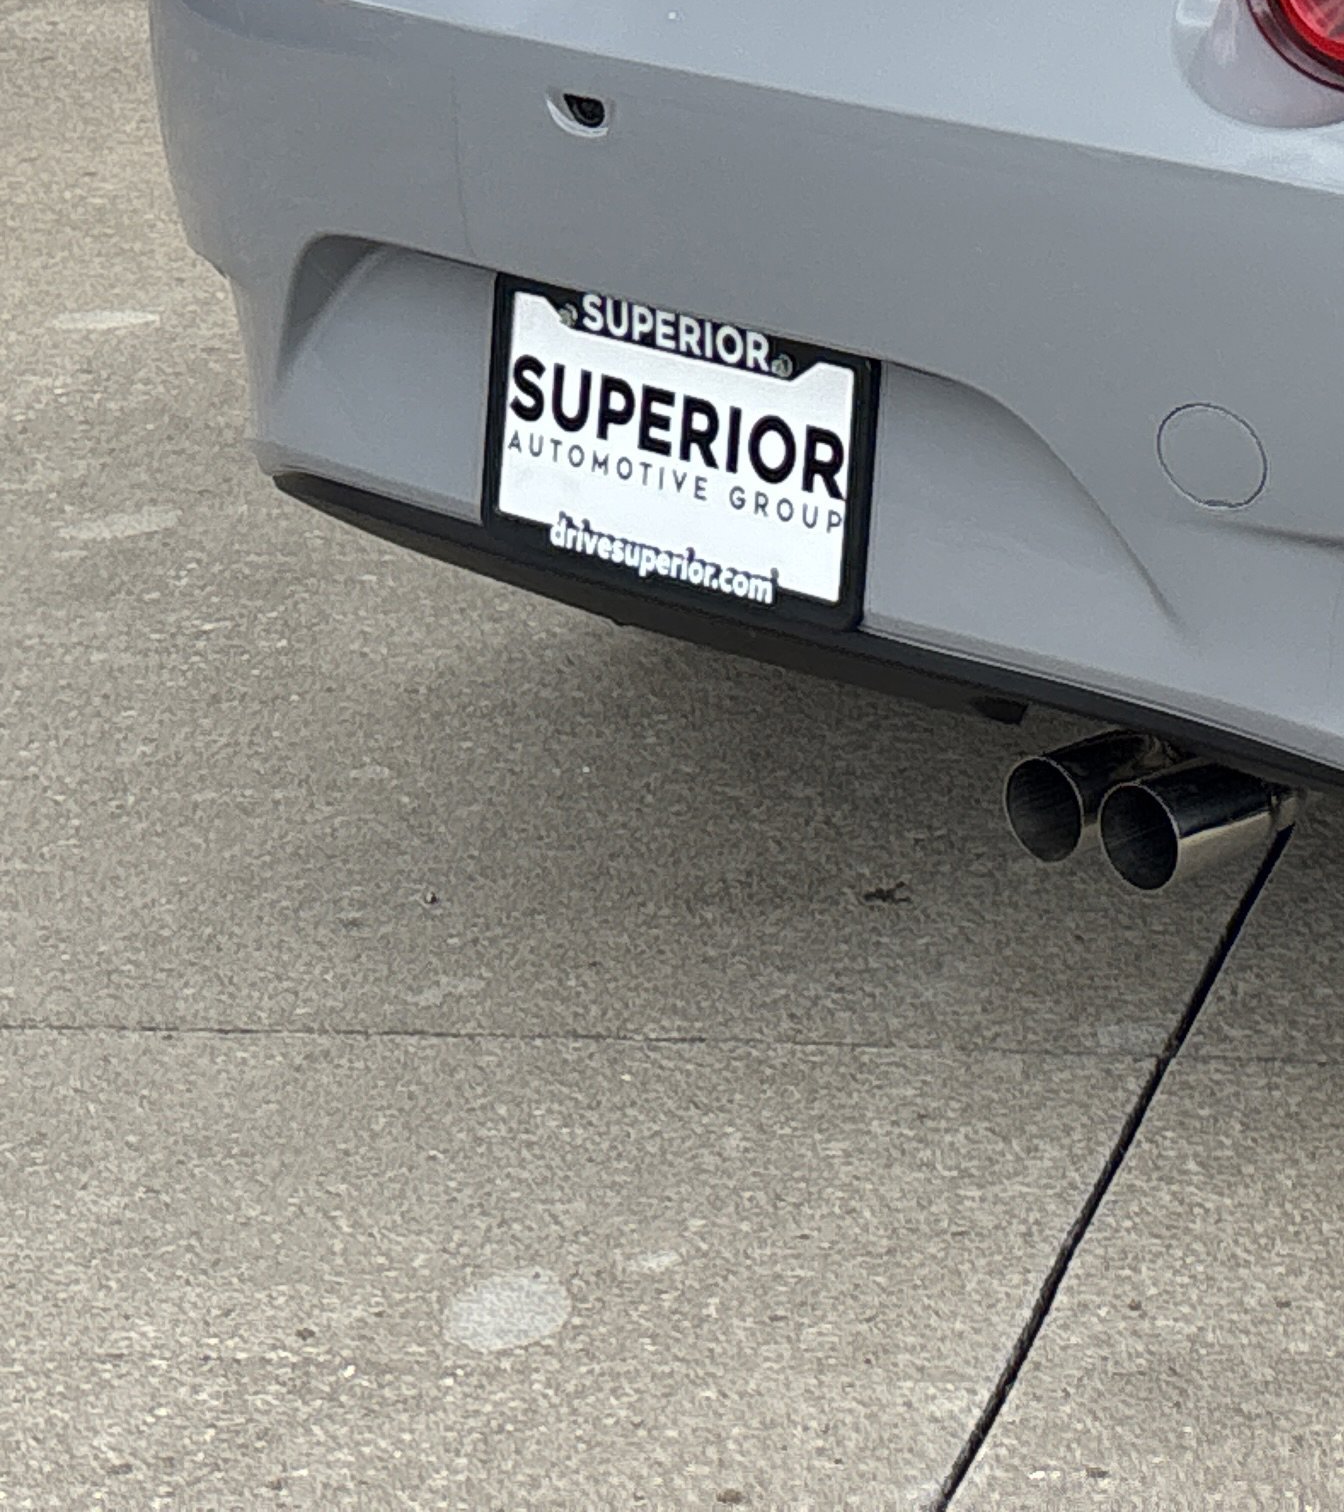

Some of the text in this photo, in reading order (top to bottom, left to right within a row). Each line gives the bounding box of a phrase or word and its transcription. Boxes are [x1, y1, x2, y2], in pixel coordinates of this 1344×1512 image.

[582, 293, 771, 372] SUPERIOR
[509, 354, 846, 500] SUPERIOR
[508, 430, 843, 534] AUTOMOTIVE GROUP
[549, 516, 776, 606] drivesuperior.com
